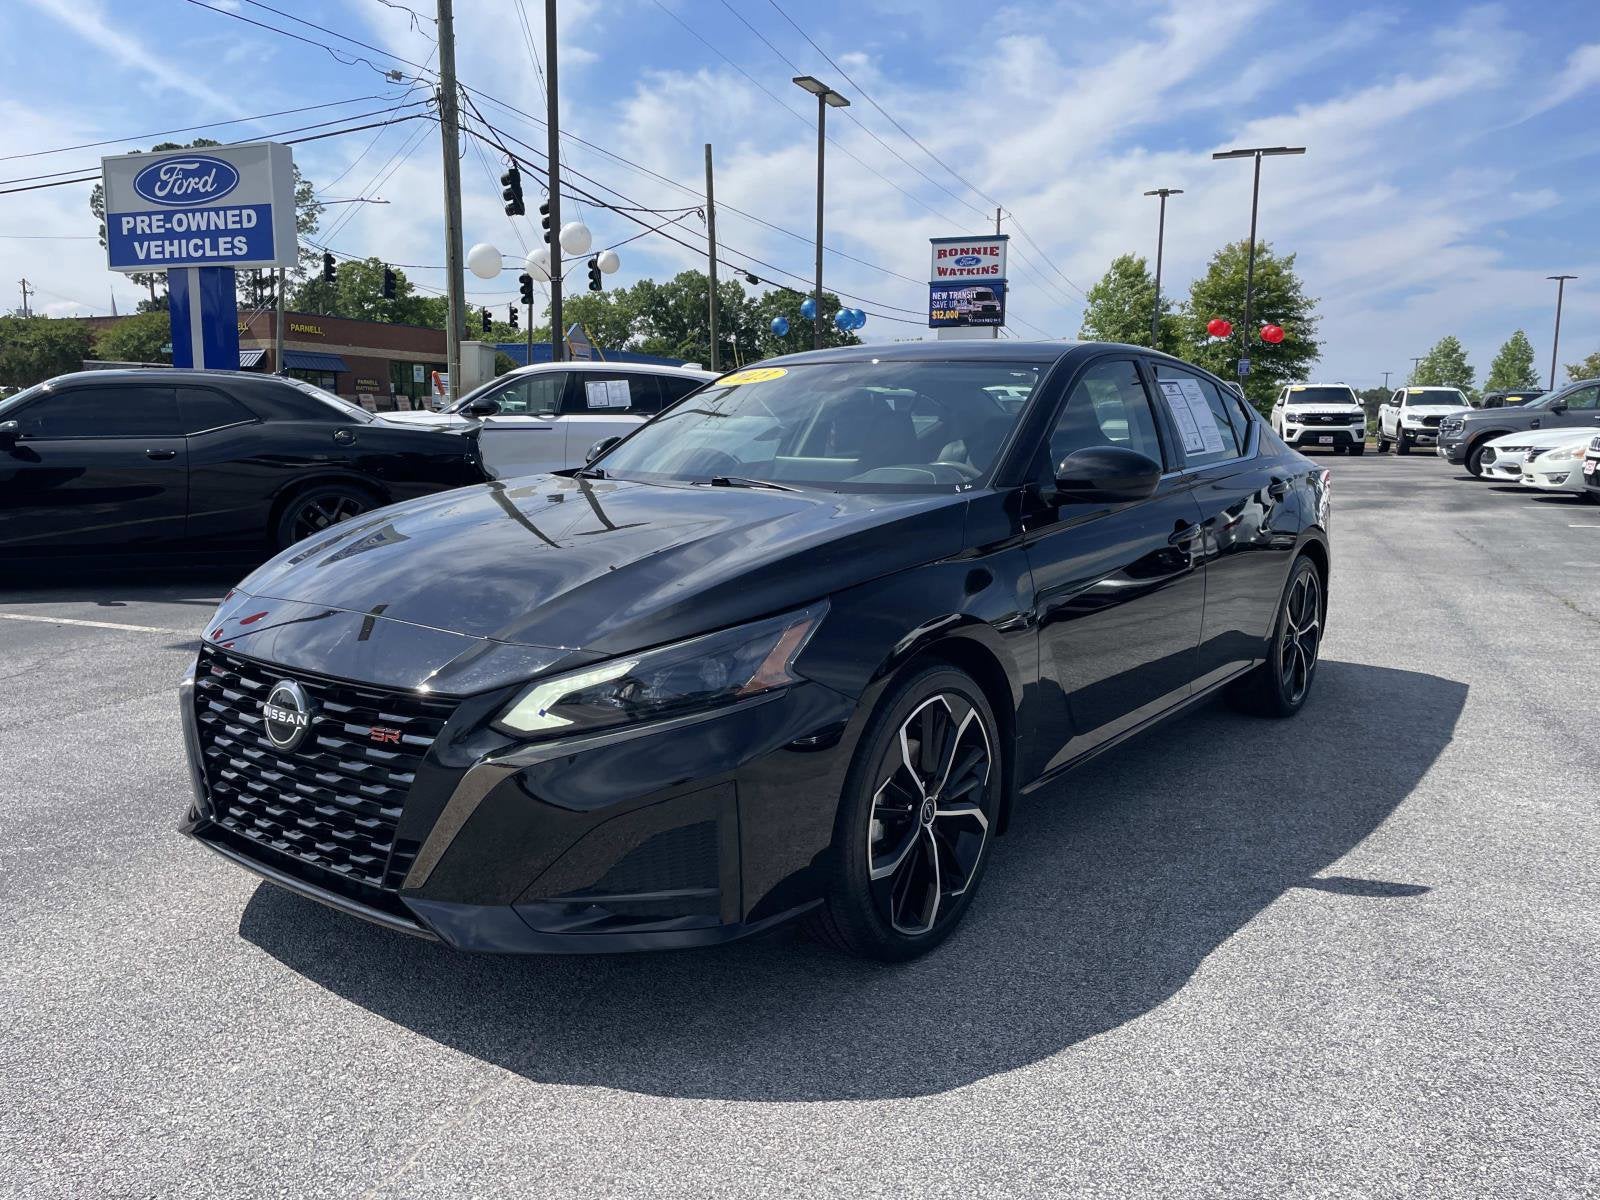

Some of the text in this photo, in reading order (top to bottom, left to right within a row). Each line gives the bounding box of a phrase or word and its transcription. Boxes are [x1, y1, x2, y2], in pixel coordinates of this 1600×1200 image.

[155, 162, 217, 196] Ford
[121, 209, 257, 235] PRE-OWNED
[133, 236, 248, 260] VEHICLES
[937, 246, 999, 259] RONNIE
[959, 257, 977, 266] Ford
[937, 264, 999, 276] WATKINS
[932, 290, 978, 300] NEW TRANSIT
[932, 300, 947, 309] SAVE
[949, 300, 957, 308] UP
[931, 310, 959, 320] $12,000
[263, 704, 308, 726] NISSAN
[369, 726, 401, 744] SR
